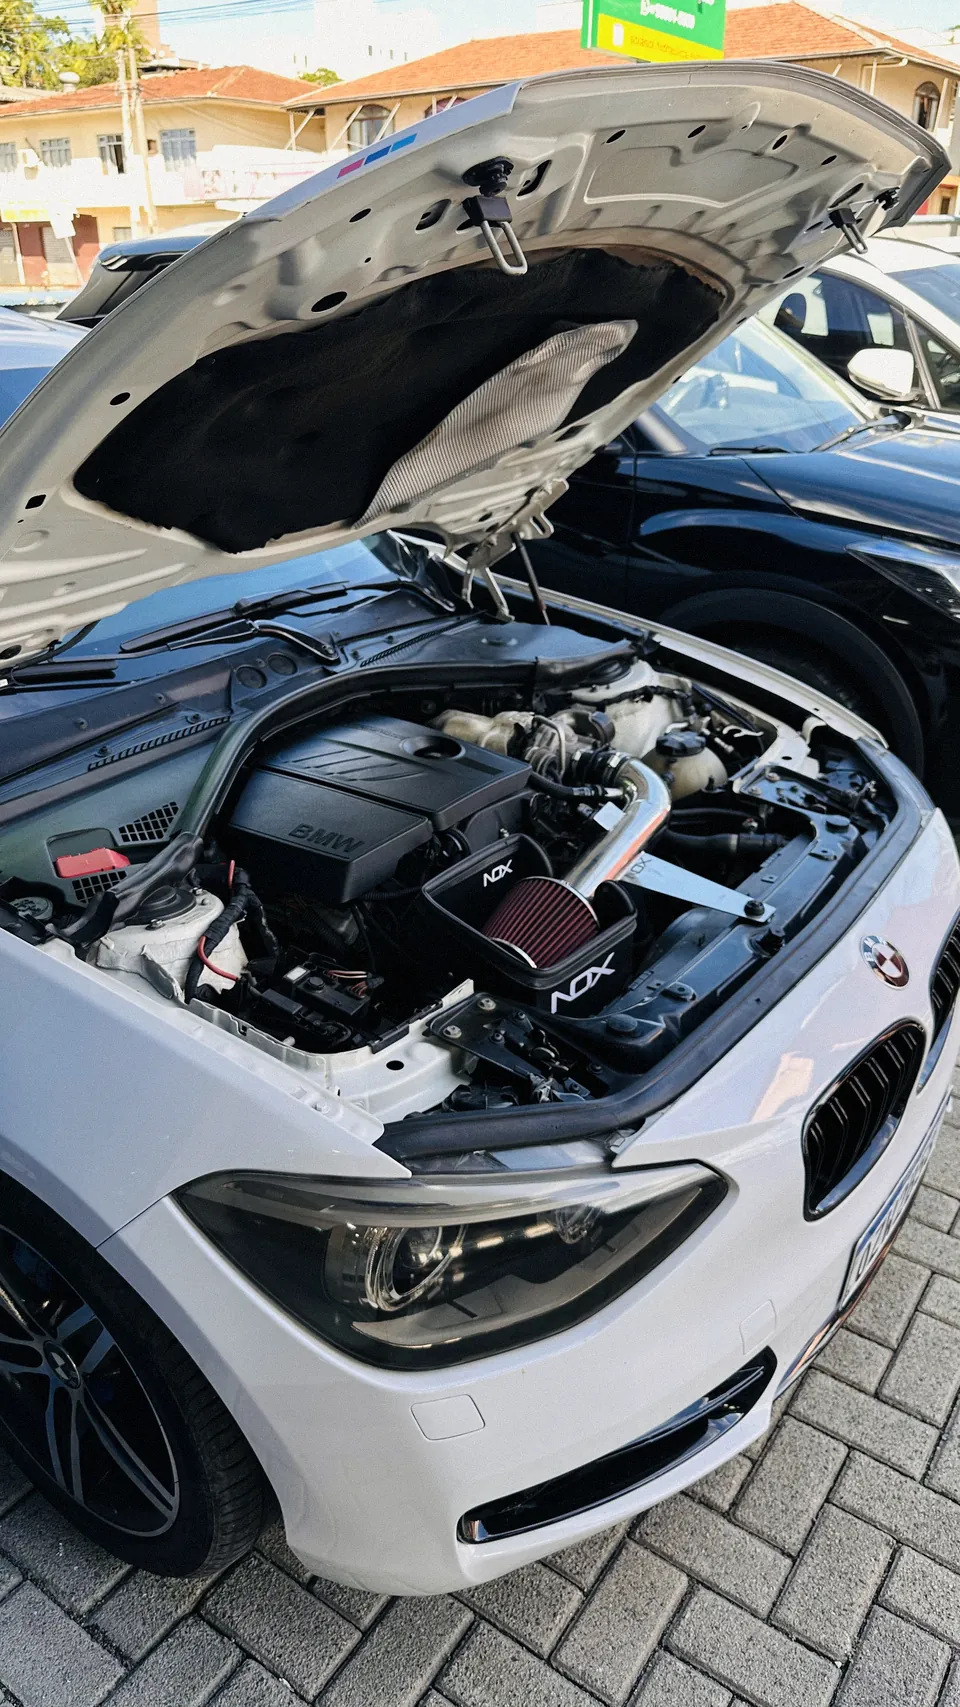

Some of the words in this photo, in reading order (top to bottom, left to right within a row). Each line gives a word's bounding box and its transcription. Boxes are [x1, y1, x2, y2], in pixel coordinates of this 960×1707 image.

[288, 823, 366, 853] BMW
[483, 859, 513, 888] NOX
[551, 951, 616, 1015] NOX
